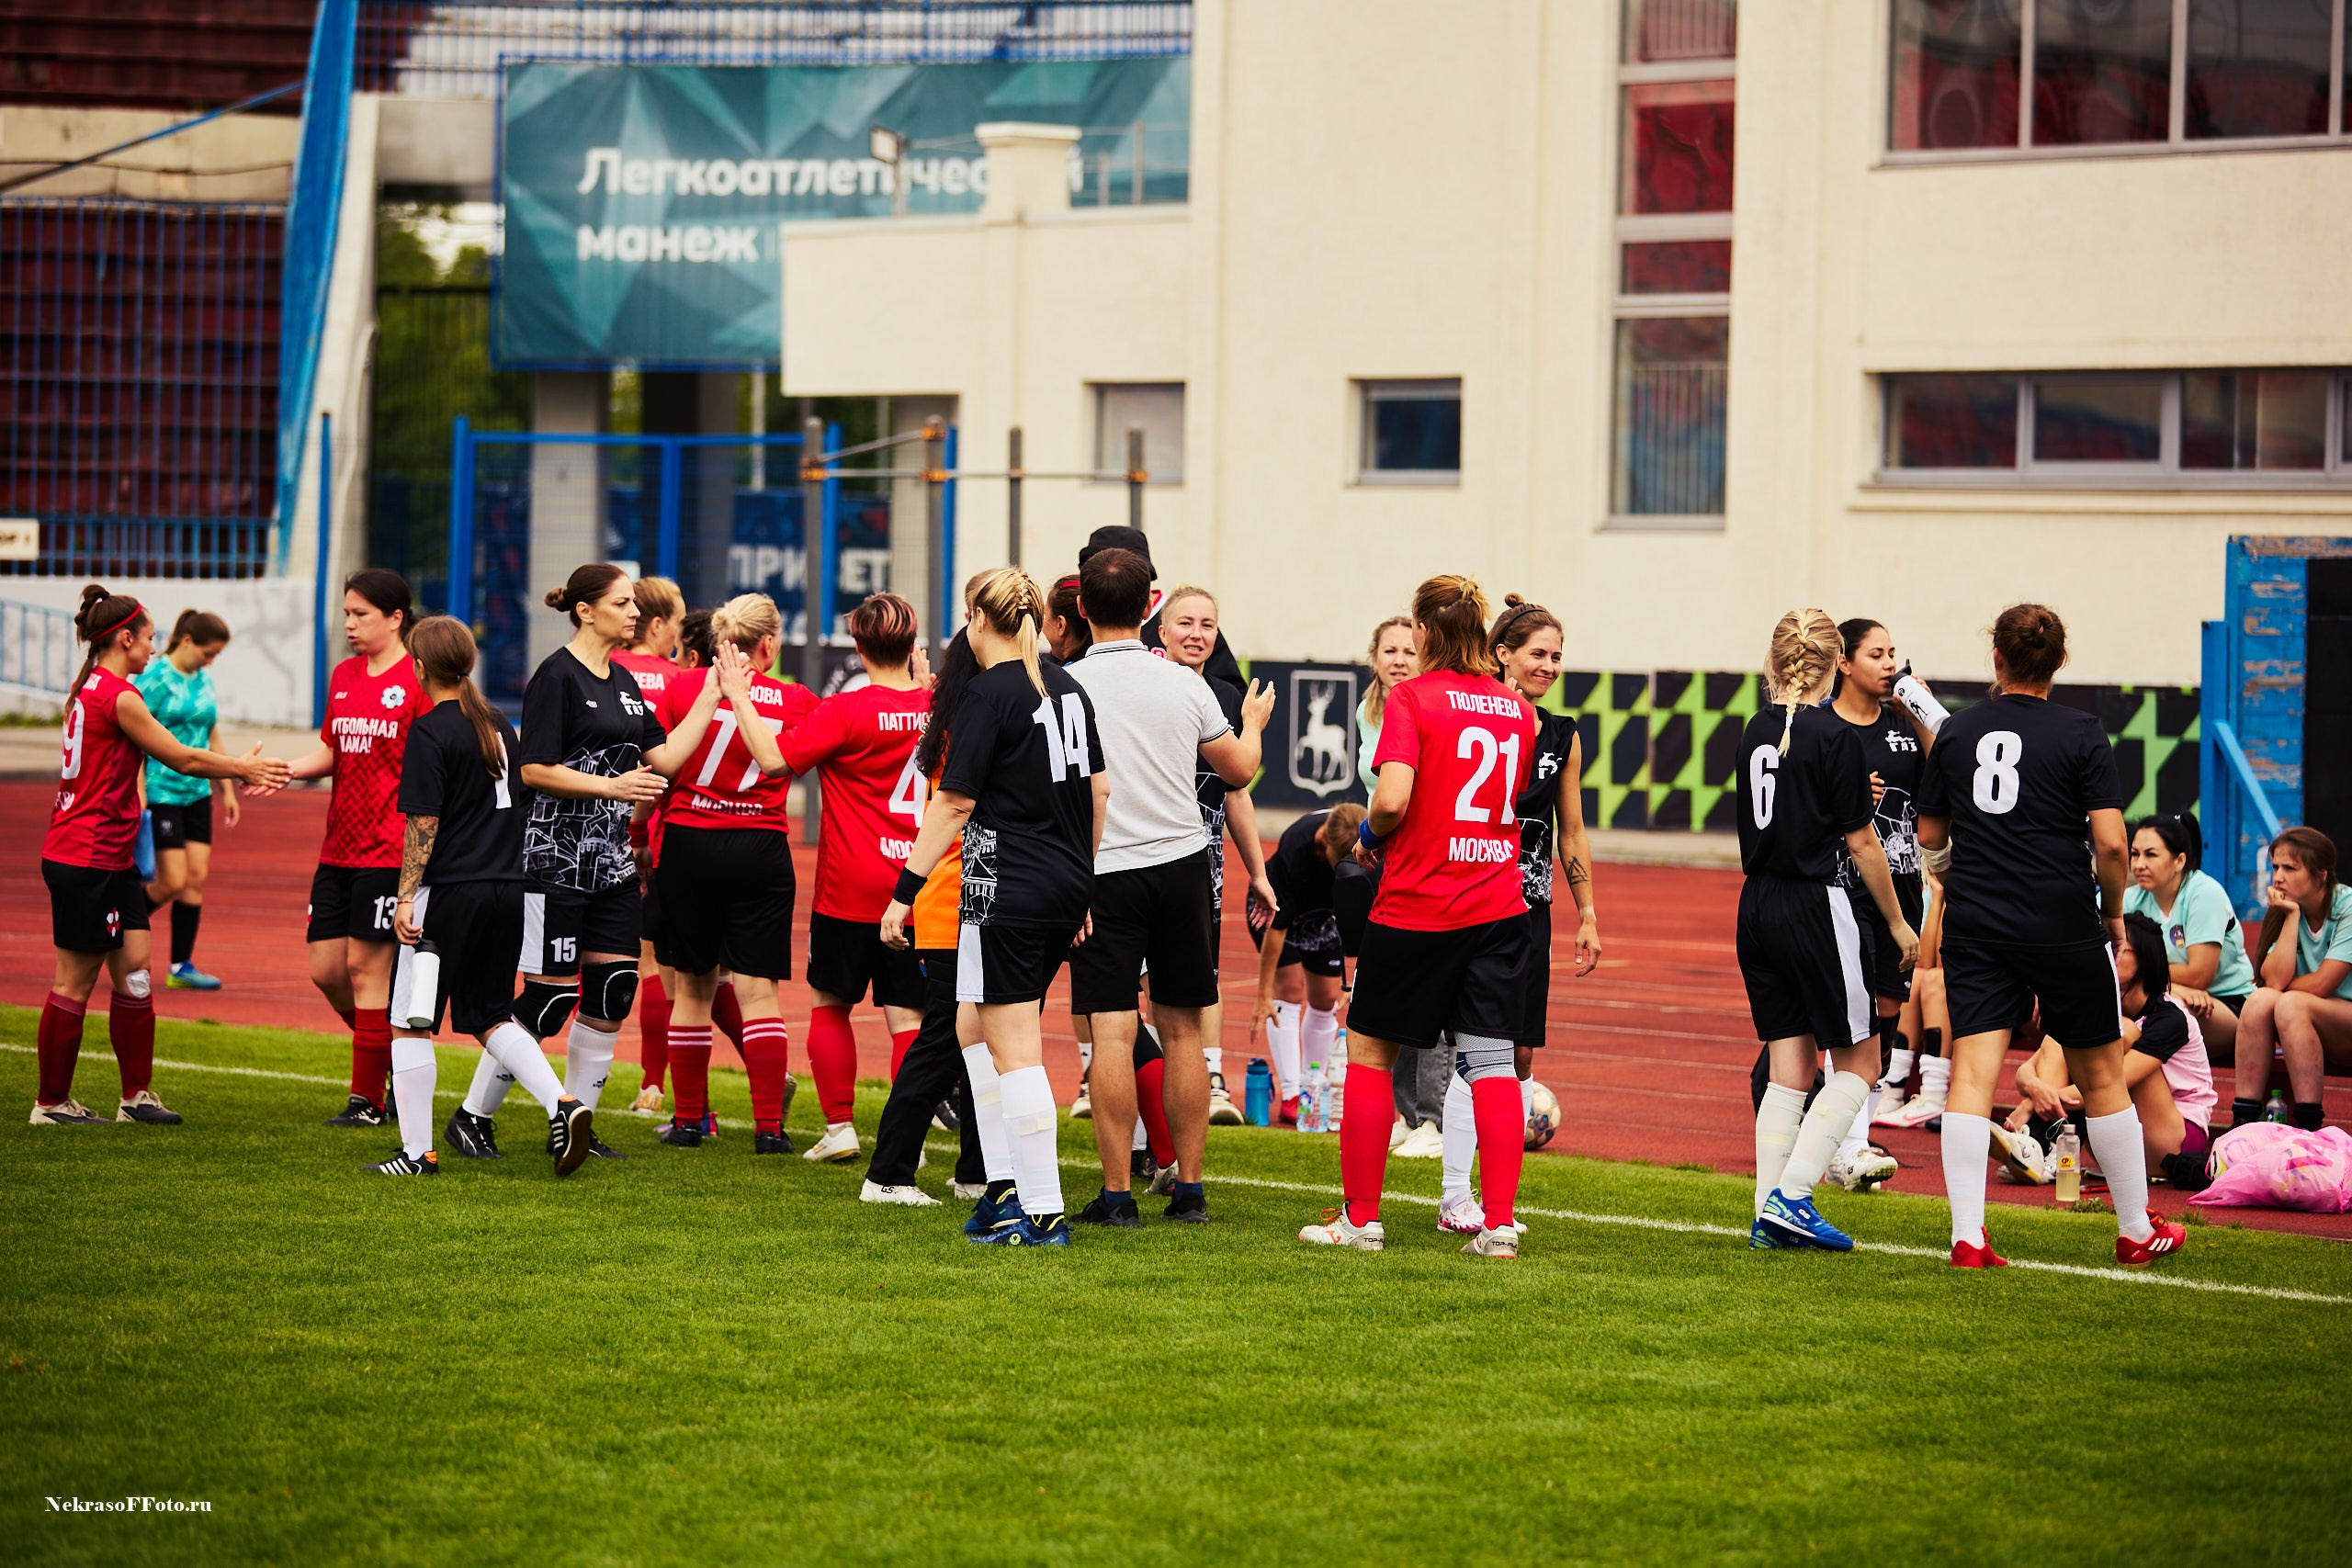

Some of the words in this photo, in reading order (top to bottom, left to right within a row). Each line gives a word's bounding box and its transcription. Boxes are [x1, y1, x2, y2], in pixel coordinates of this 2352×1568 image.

[577, 224, 759, 263] манеж
[726, 546, 891, 595] ПРИЕТ
[1033, 693, 1091, 783] 14
[1445, 690, 1522, 720] ТЮЛЕНЕВА
[695, 708, 784, 792] 77
[1454, 726, 1520, 825] 21
[1973, 730, 2022, 814] 8
[888, 745, 928, 828] 4
[1749, 744, 1779, 829] 6
[1449, 837, 1514, 863] МОСКВА
[374, 896, 397, 930] 13
[551, 936, 576, 962] 15
